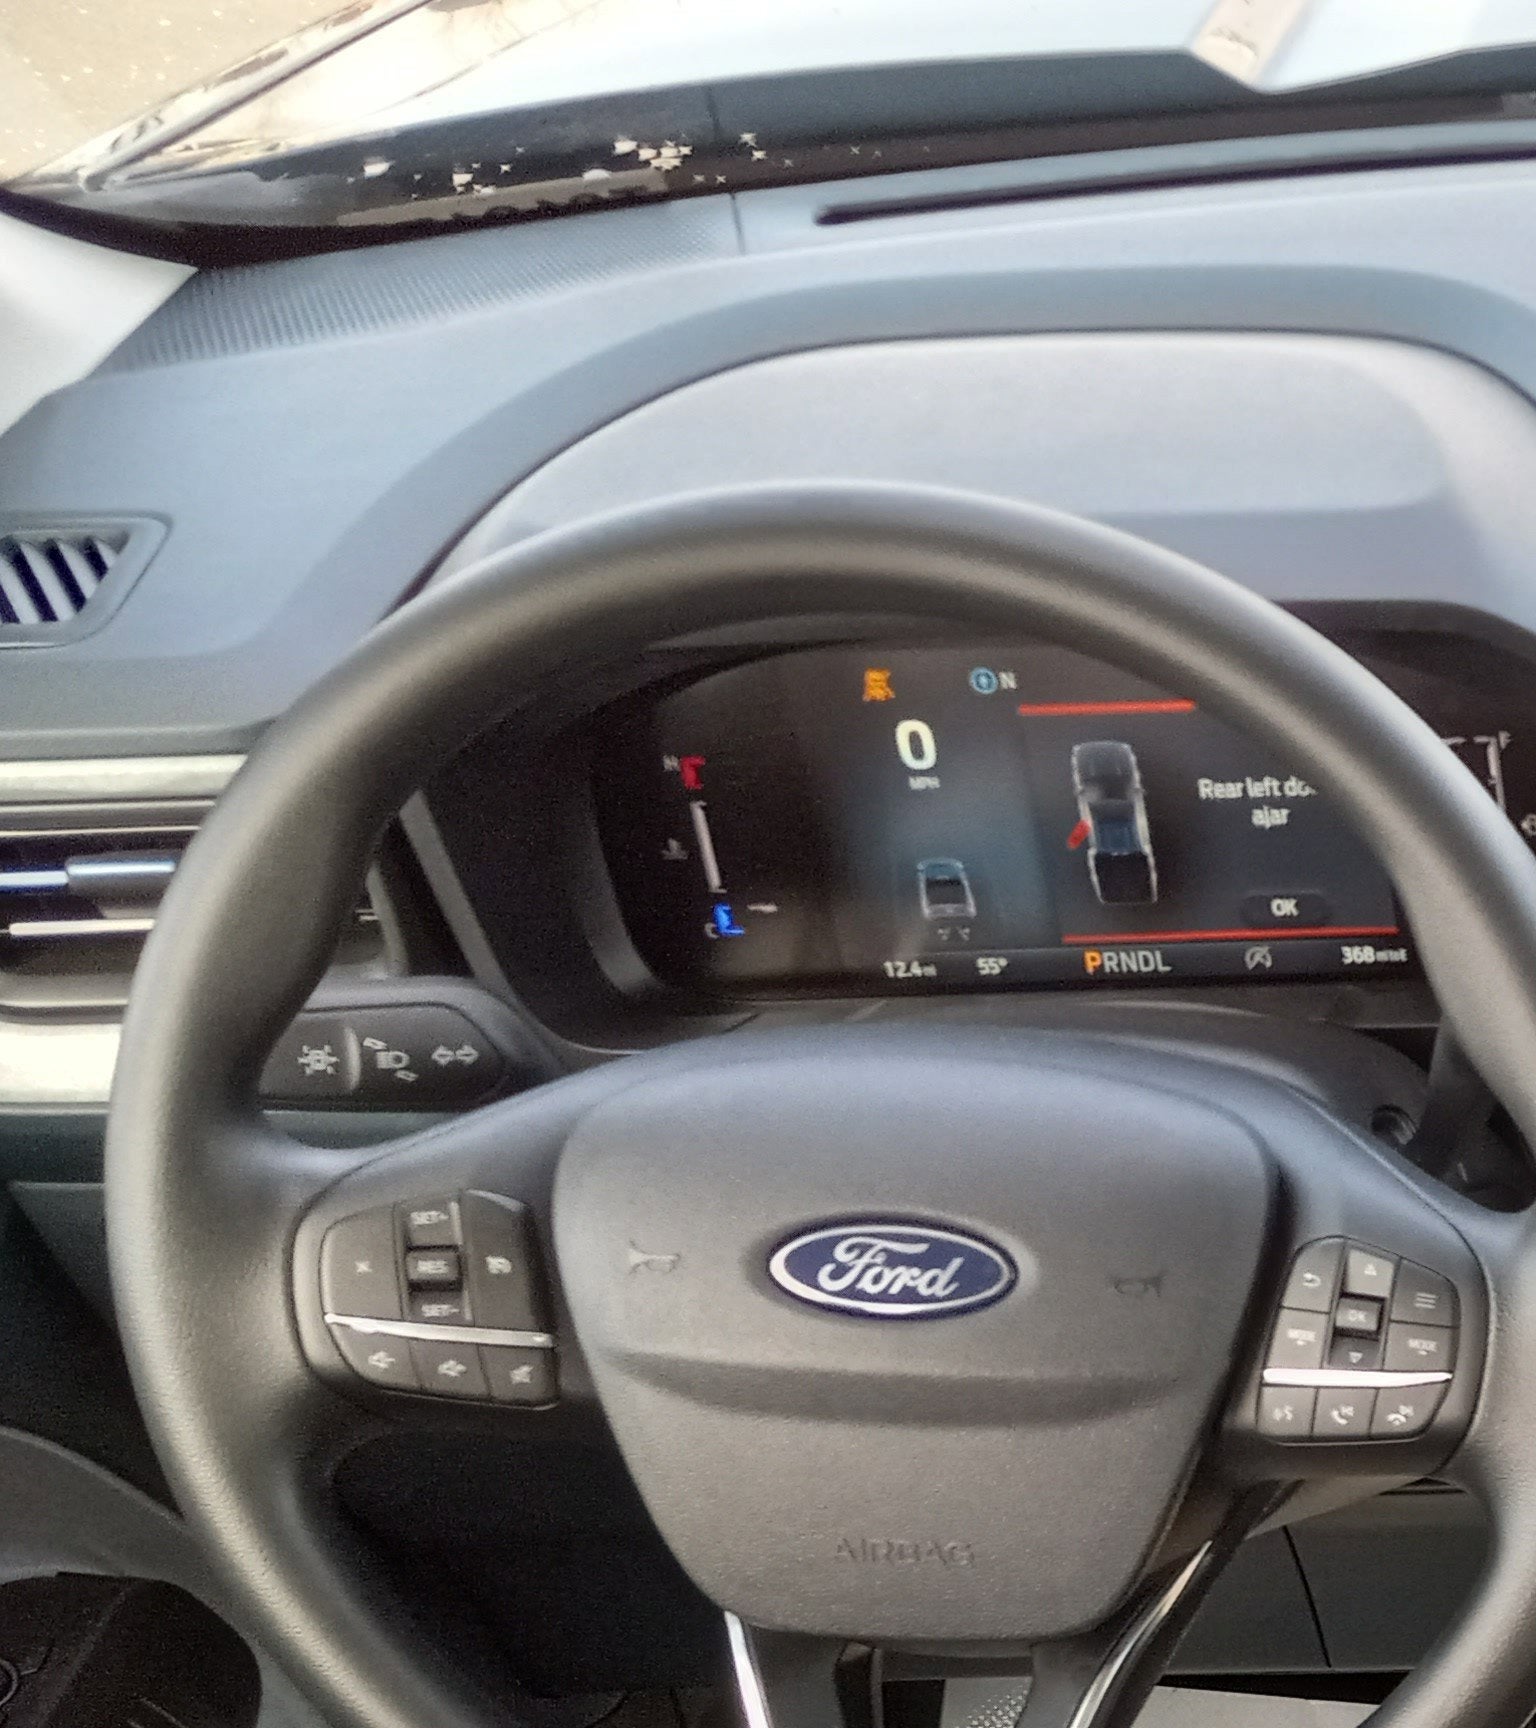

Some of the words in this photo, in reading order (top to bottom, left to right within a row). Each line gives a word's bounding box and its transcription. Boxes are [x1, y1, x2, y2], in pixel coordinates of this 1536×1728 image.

[895, 719, 937, 770] 0
[1198, 778, 1243, 800] Rear
[1245, 776, 1282, 798] left
[1283, 775, 1318, 798] do
[1251, 805, 1290, 830] ajar
[1270, 898, 1299, 917] OK
[1341, 945, 1375, 965] 368
[817, 1236, 962, 1298] Ford
